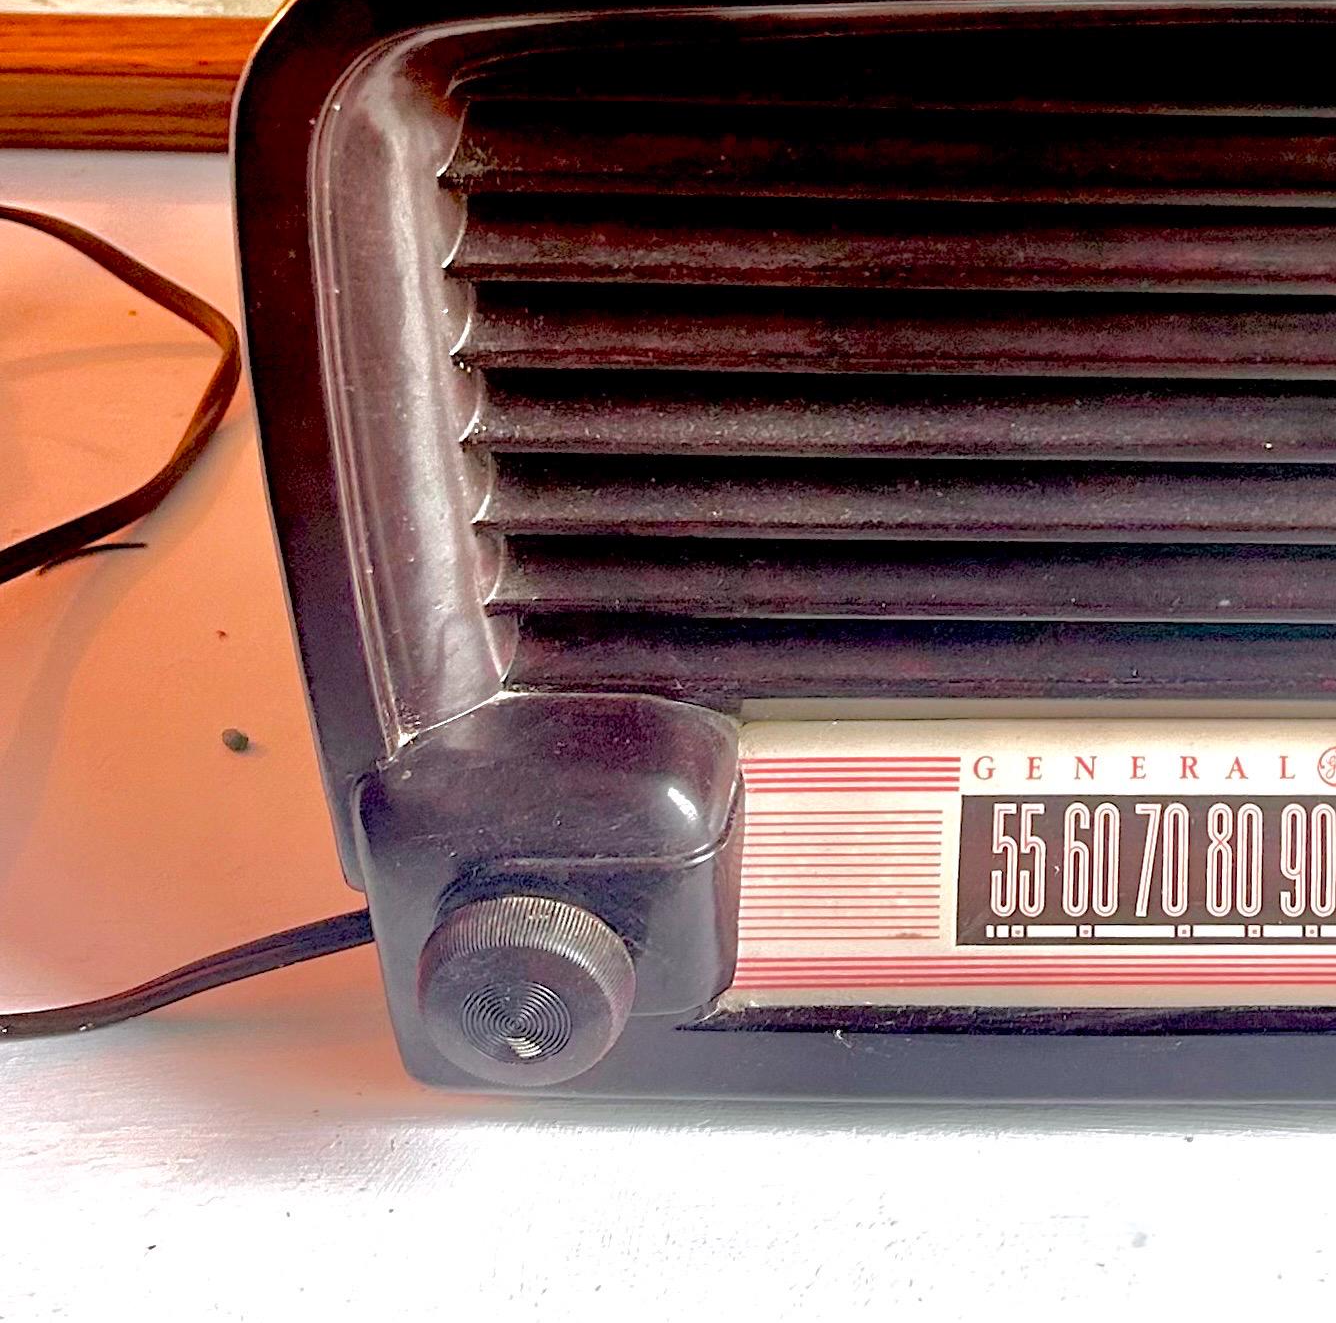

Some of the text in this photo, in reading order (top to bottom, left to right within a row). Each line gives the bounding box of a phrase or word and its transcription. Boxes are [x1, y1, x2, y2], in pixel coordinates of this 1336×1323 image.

[973, 756, 1296, 780] GENERAL
[990, 803, 1046, 917] 55
[1062, 803, 1120, 917] 60
[1135, 803, 1189, 917] 70
[1206, 803, 1263, 917] 80
[1279, 803, 1336, 917] 90
